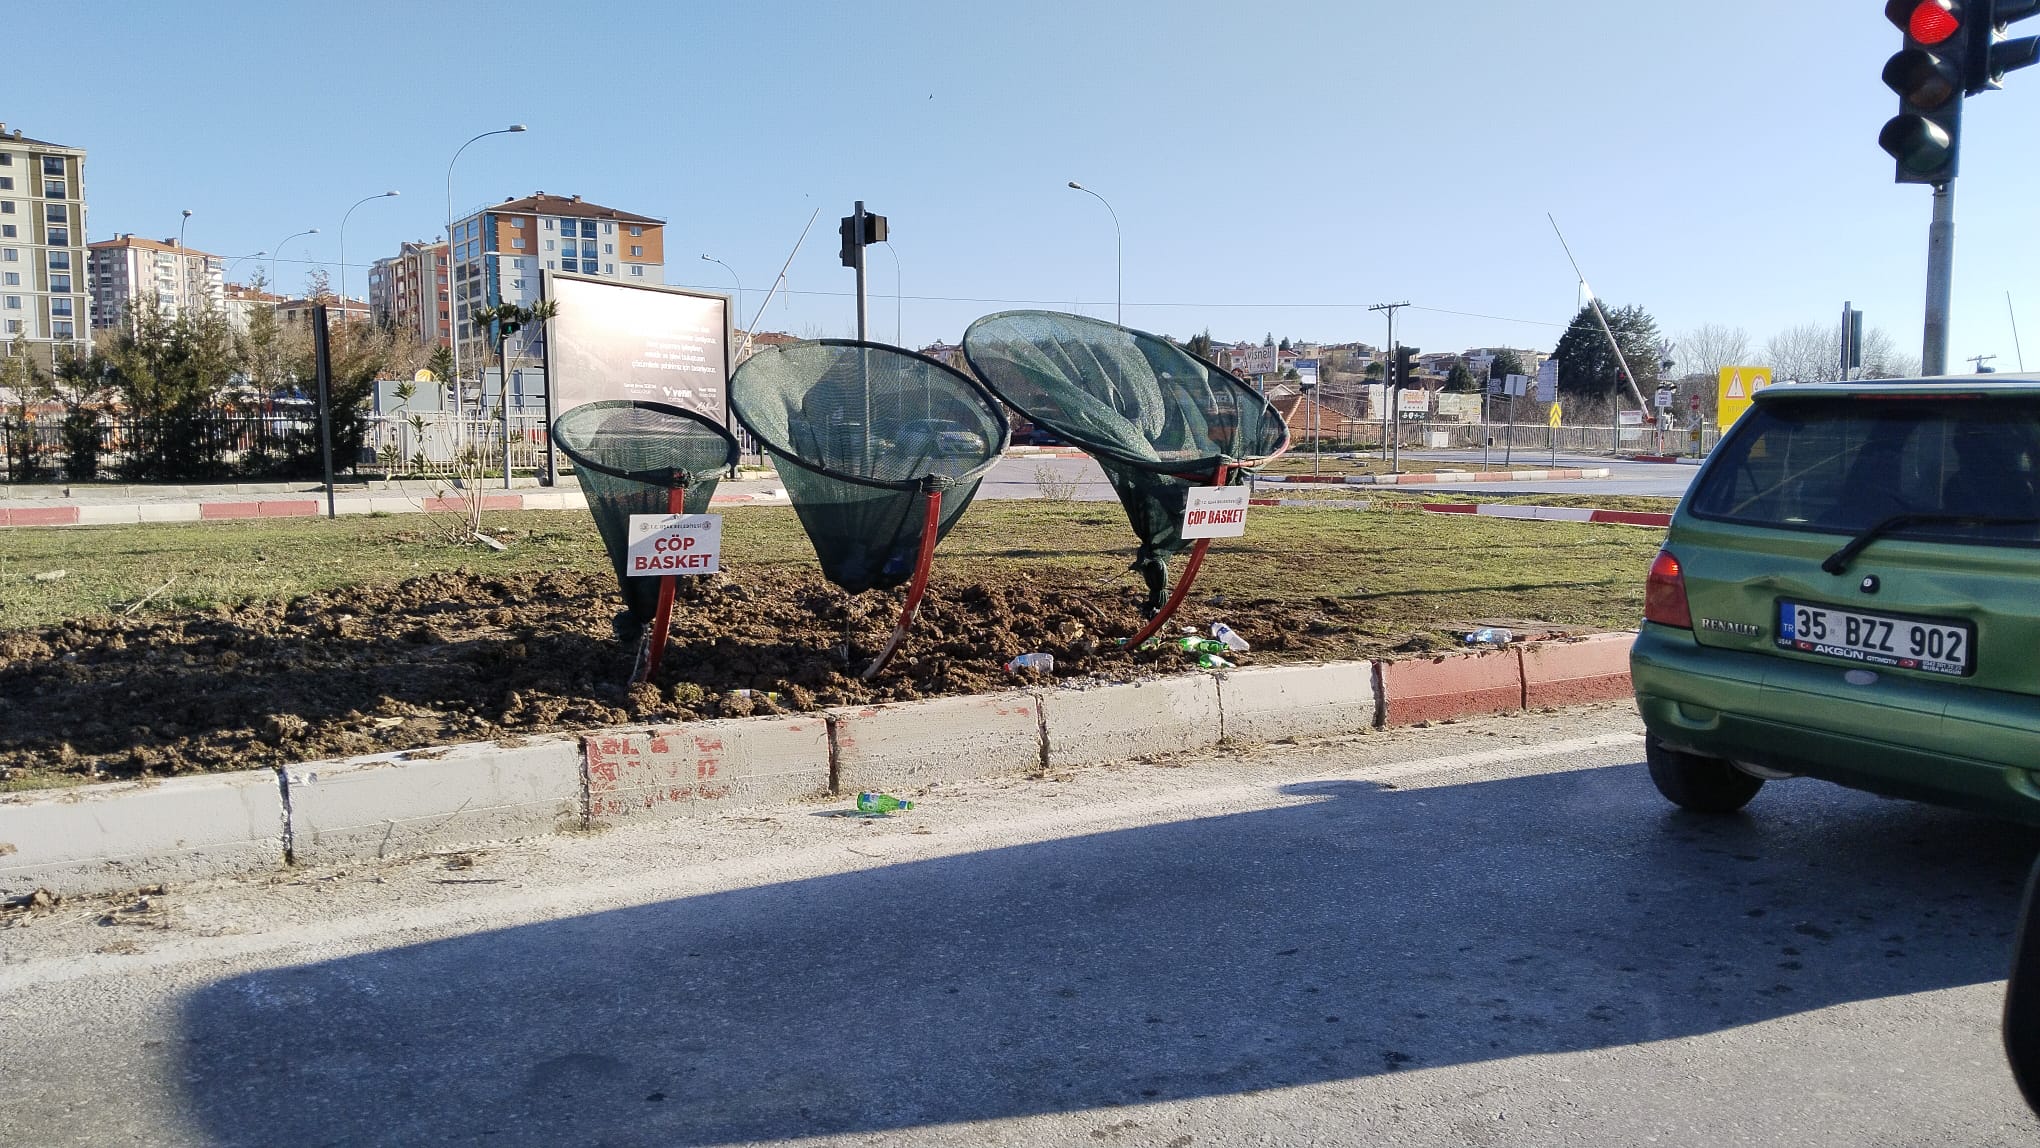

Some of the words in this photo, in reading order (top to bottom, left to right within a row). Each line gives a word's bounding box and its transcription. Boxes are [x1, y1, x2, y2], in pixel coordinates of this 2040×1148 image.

[1187, 508, 1207, 527] ÇÖP
[1208, 509, 1244, 524] BASKET
[654, 534, 695, 554] ÇÖP
[635, 554, 712, 570] BASKET
[1701, 618, 1759, 636] RENAULT
[1783, 623, 1794, 633] TR
[1797, 609, 1827, 640] 35
[1845, 616, 1894, 652] BZZ
[1910, 626, 1963, 662] 902
[1814, 644, 1864, 659] AKGÜN
